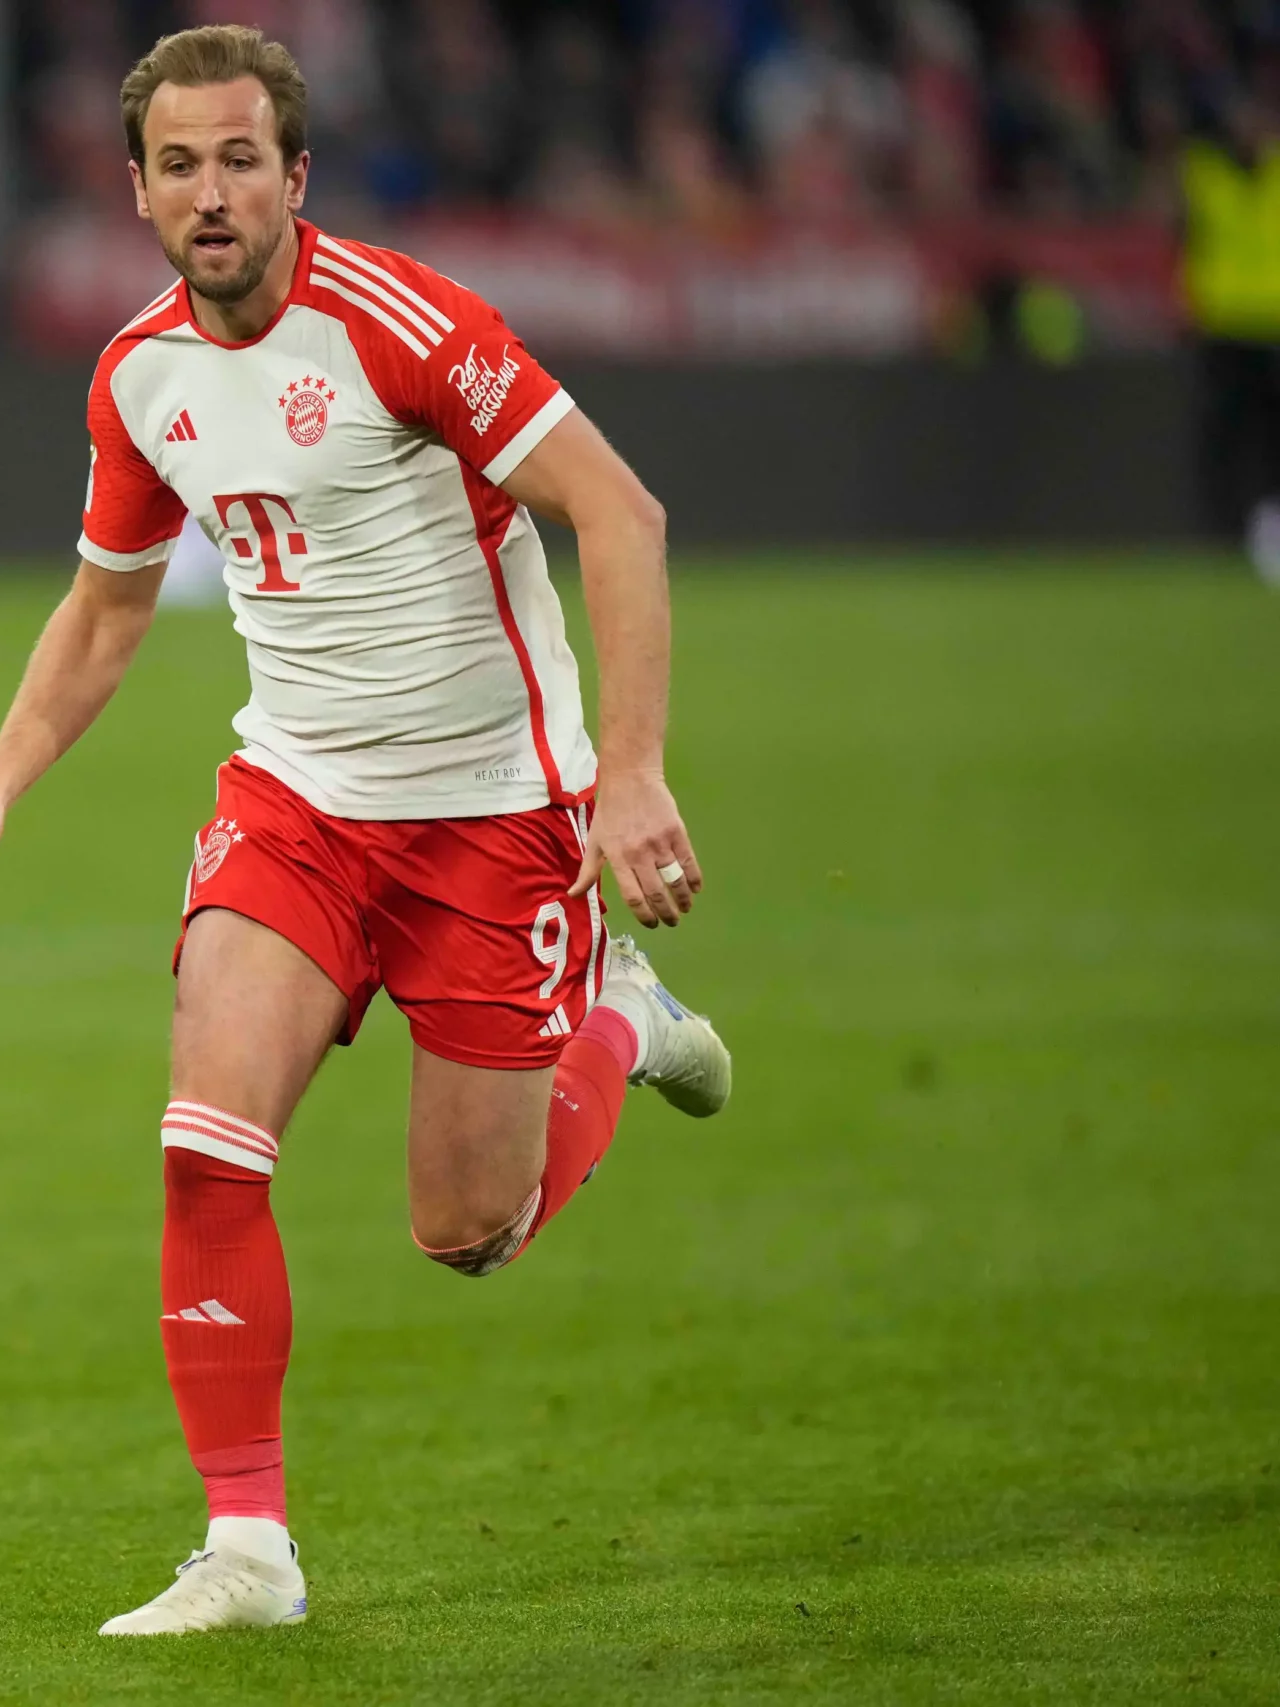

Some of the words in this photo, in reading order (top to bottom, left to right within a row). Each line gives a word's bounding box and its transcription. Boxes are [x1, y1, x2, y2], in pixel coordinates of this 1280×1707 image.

[289, 405, 297, 416] FC
[297, 395, 323, 413] BAYERN
[466, 357, 496, 410] GEGEN
[470, 344, 521, 437] RASSISMUS
[531, 901, 569, 999] 9
